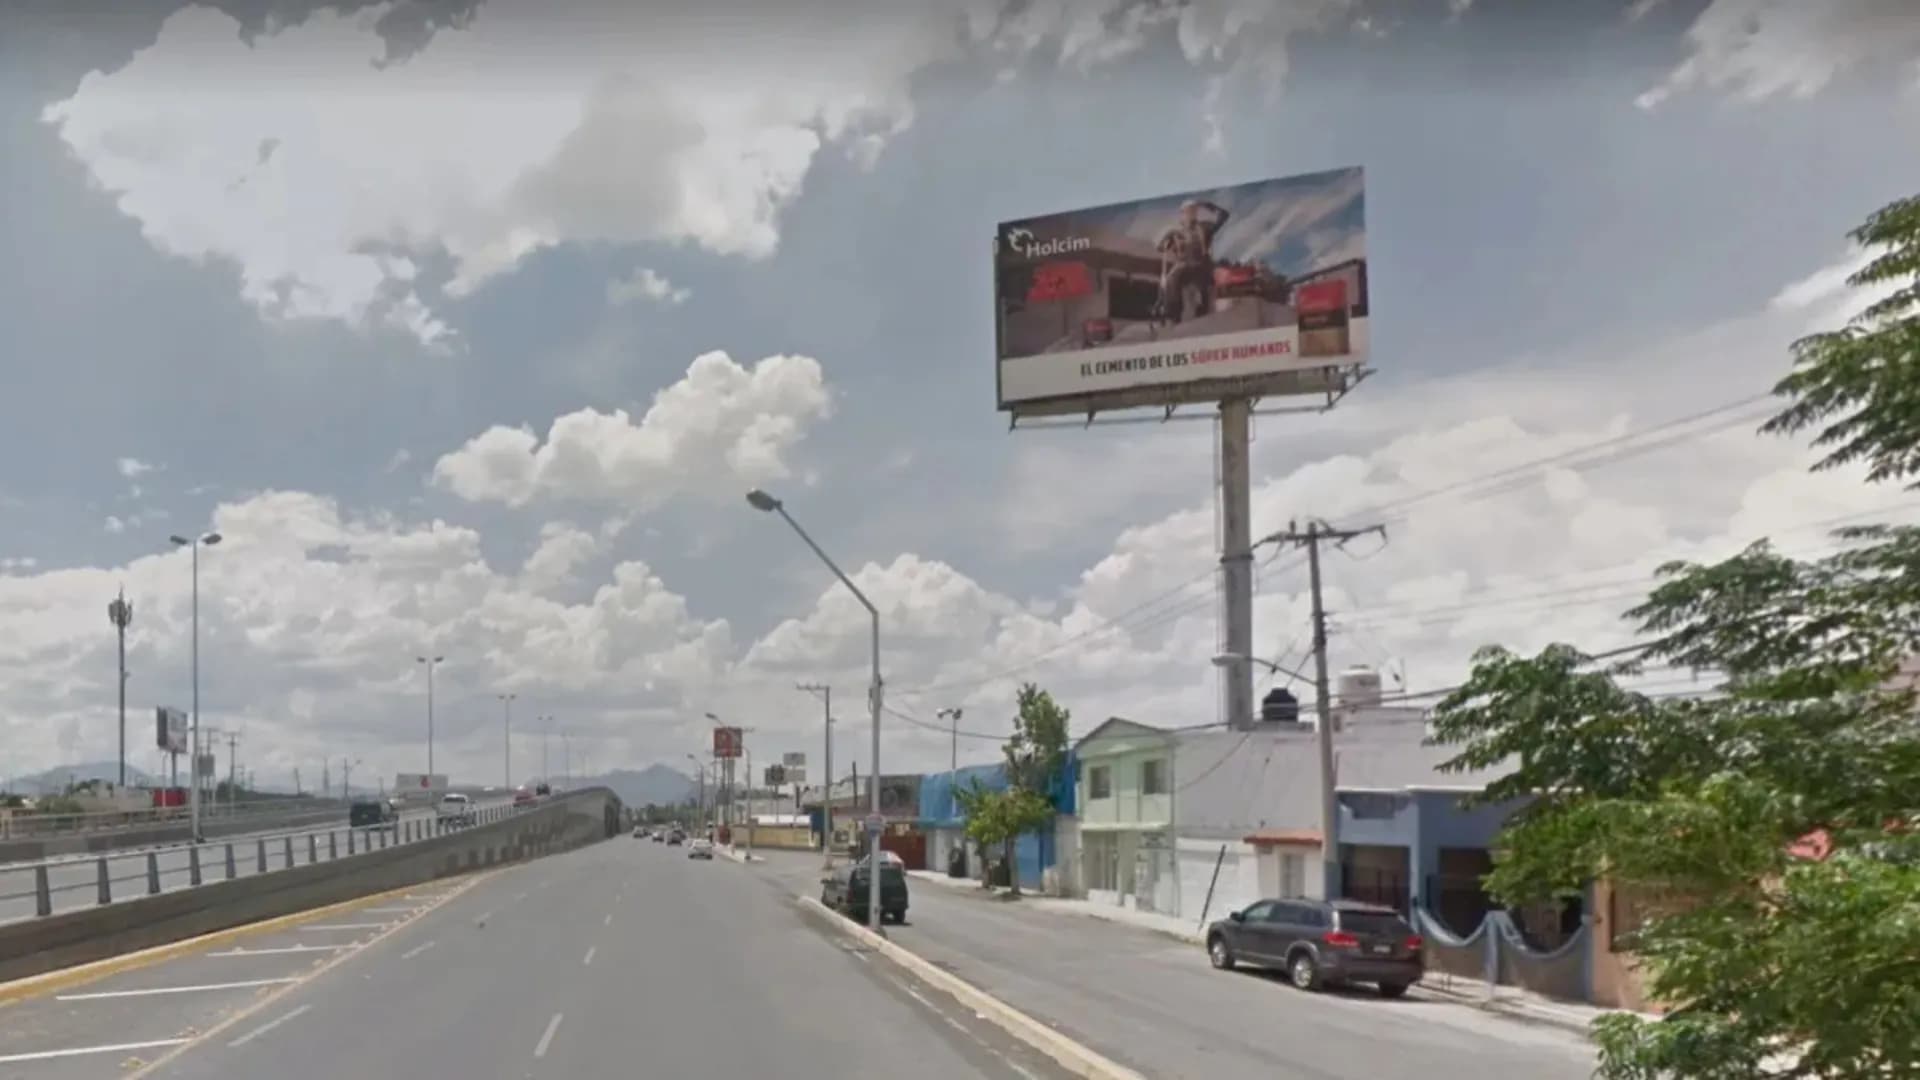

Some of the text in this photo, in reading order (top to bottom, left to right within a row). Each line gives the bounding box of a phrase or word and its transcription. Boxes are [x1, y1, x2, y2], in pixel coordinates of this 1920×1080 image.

[1026, 236, 1090, 258] Holcim
[1080, 363, 1094, 377] EL
[1096, 356, 1146, 374] CEMENTO
[1150, 354, 1163, 369] DE
[1167, 352, 1189, 367] LOS
[1232, 340, 1291, 360] HUMANOS
